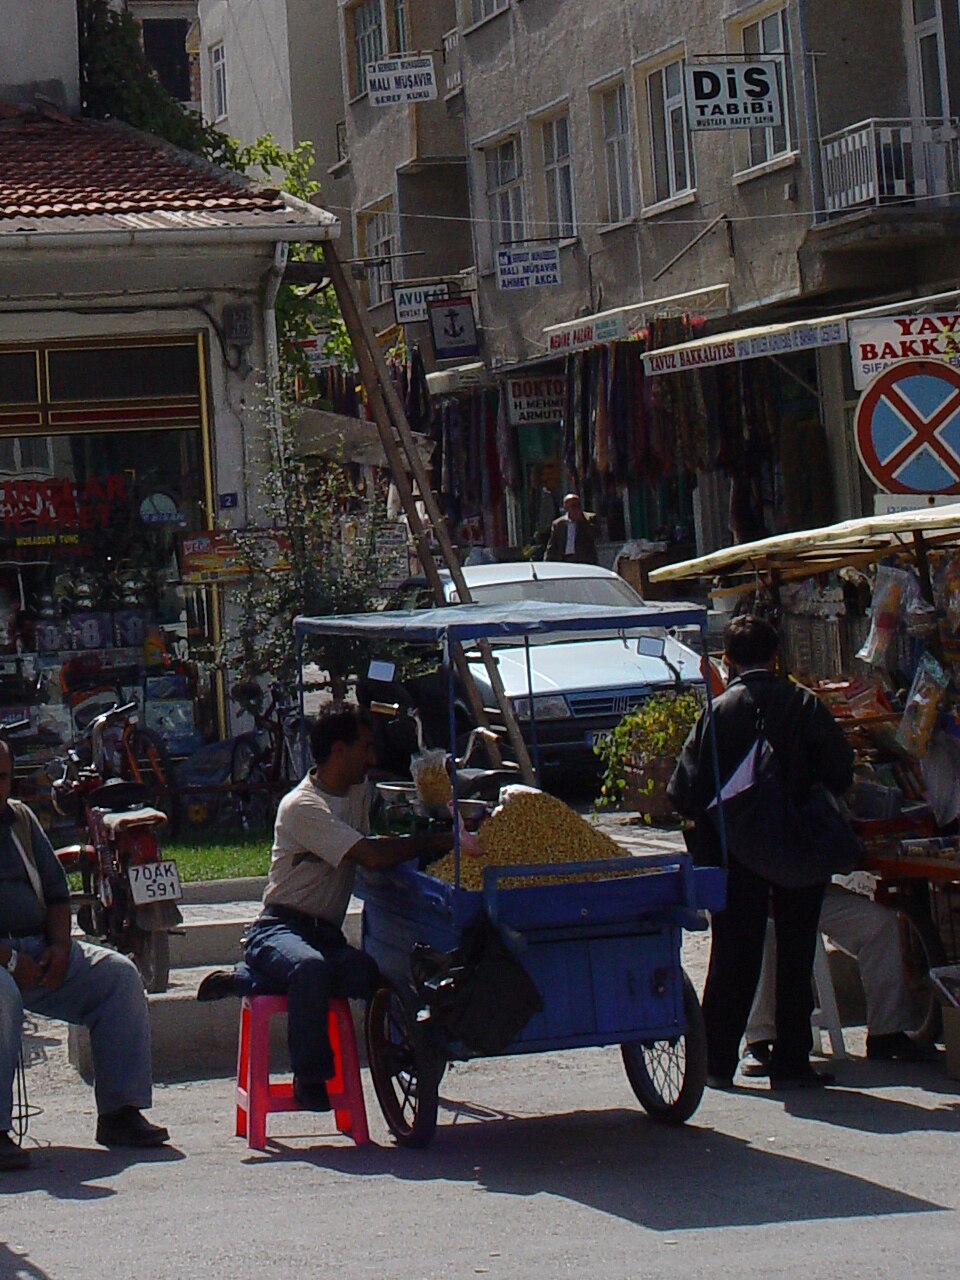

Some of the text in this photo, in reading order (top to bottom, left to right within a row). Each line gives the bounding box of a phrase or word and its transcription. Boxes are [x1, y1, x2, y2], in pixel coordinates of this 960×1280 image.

[511, 379, 564, 399] DOKTO
[225, 498, 232, 506] 2
[146, 881, 176, 898] 591
